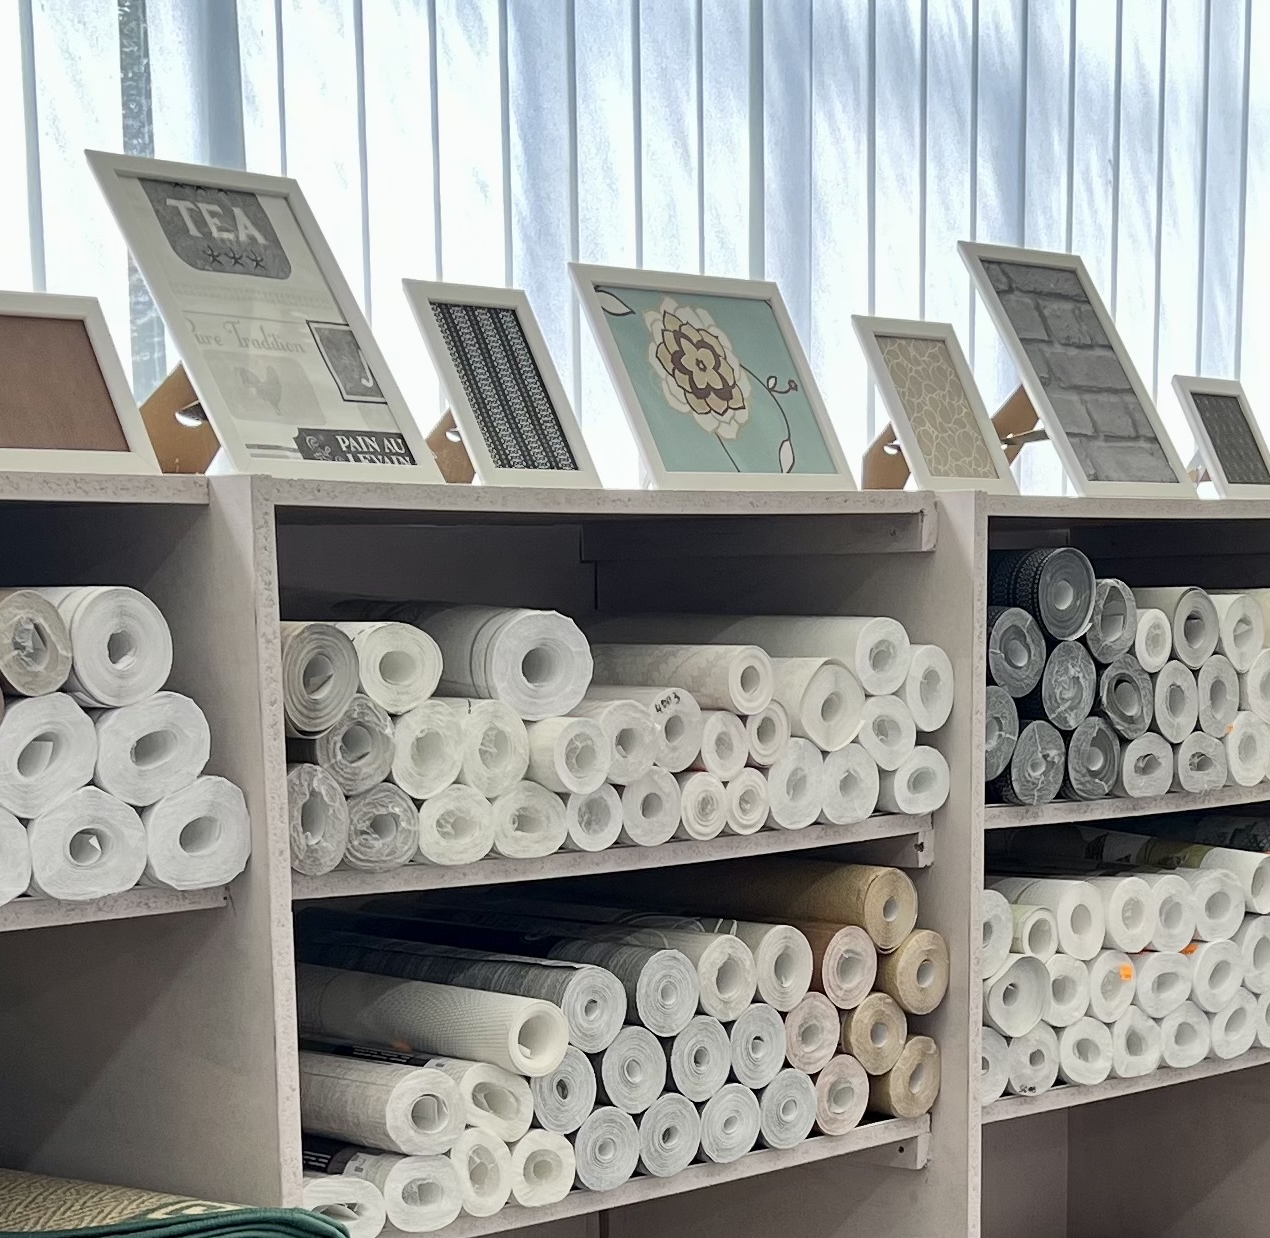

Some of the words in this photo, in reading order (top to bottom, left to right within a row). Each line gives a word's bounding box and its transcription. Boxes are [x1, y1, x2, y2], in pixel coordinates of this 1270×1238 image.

[166, 198, 268, 245] TEA
[224, 319, 306, 353] Tradition
[335, 435, 380, 453] PAIN
[384, 437, 406, 453] AU
